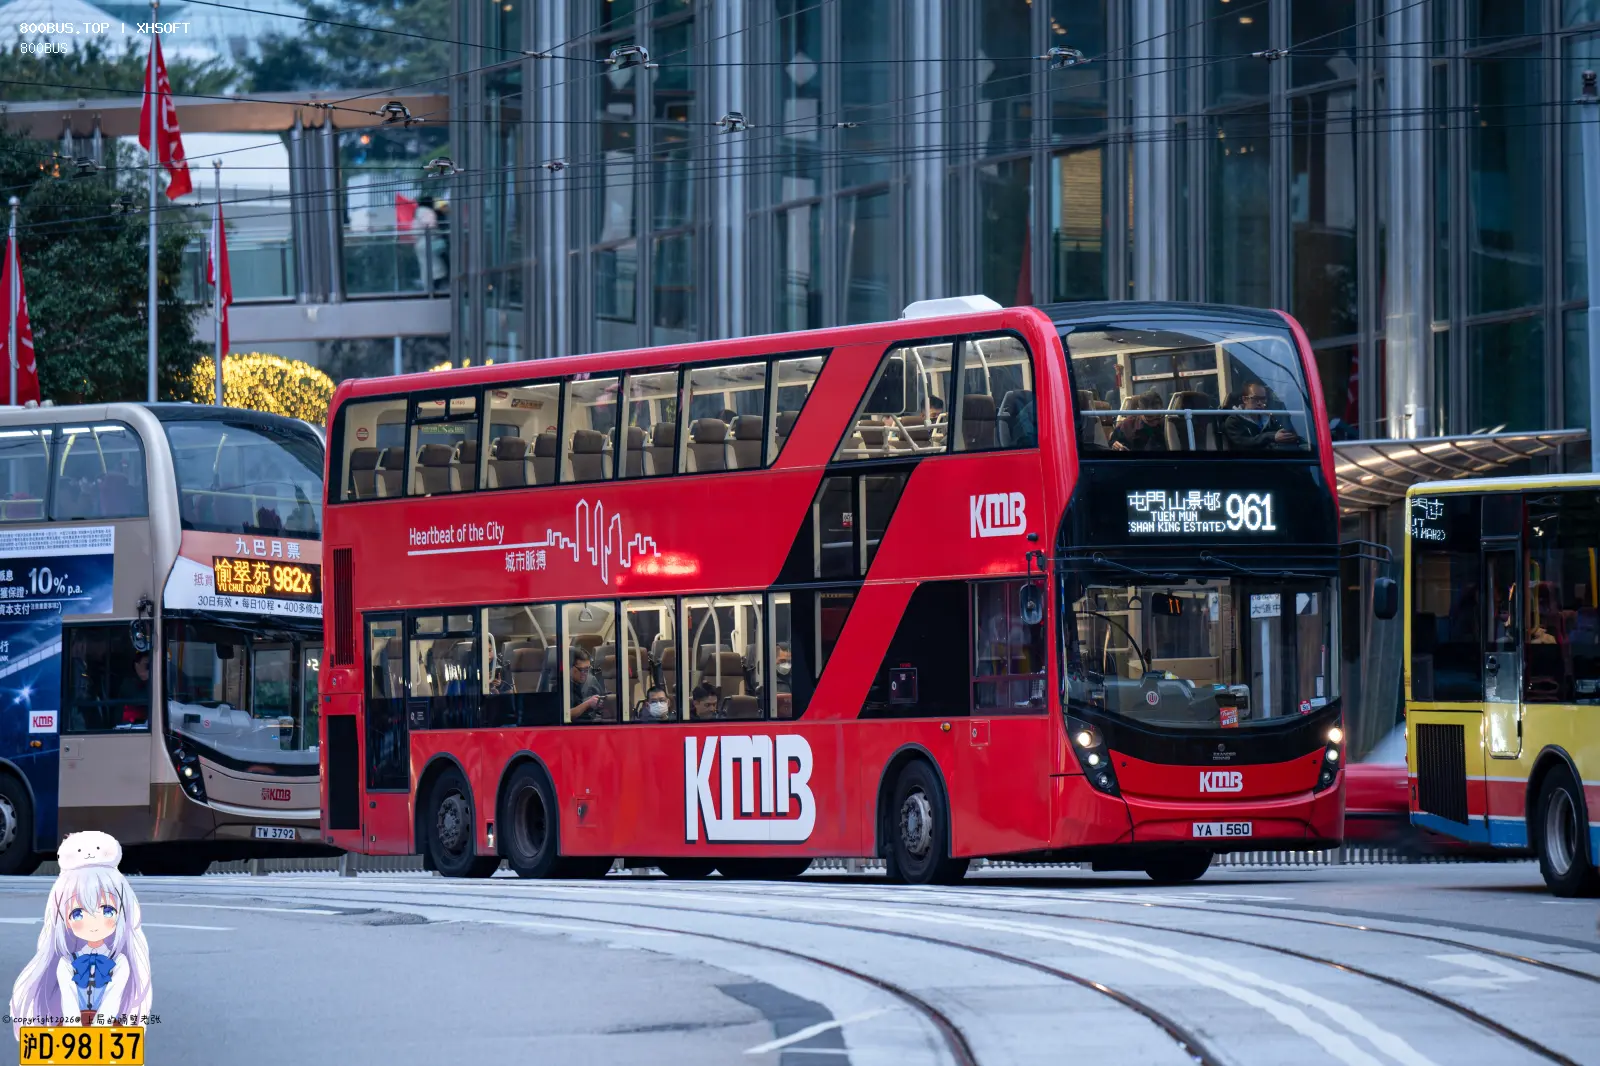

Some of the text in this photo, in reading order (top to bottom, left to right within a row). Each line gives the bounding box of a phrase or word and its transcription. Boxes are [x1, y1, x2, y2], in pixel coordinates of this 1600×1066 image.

[1127, 490, 1221, 512] 屯門山景邨
[969, 491, 1027, 539] KMB
[1150, 511, 1198, 522] TUEN MUN
[1226, 493, 1276, 532] 961
[409, 521, 505, 546] Heartbeat of the City
[1157, 521, 1181, 533] KING
[1184, 521, 1227, 533] ESTATE)
[235, 537, 301, 560] 九巴月票
[504, 549, 547, 572] 城市脈搏
[215, 557, 271, 587] 愉翠苑
[67, 584, 83, 597] p.a.
[218, 582, 267, 595] YU CHUI COURT
[32, 715, 54, 728] KMB
[684, 734, 817, 845] KMB
[1199, 771, 1244, 793] KMB
[257, 827, 294, 839] TW 3792
[1197, 823, 1250, 836] YA 1560
